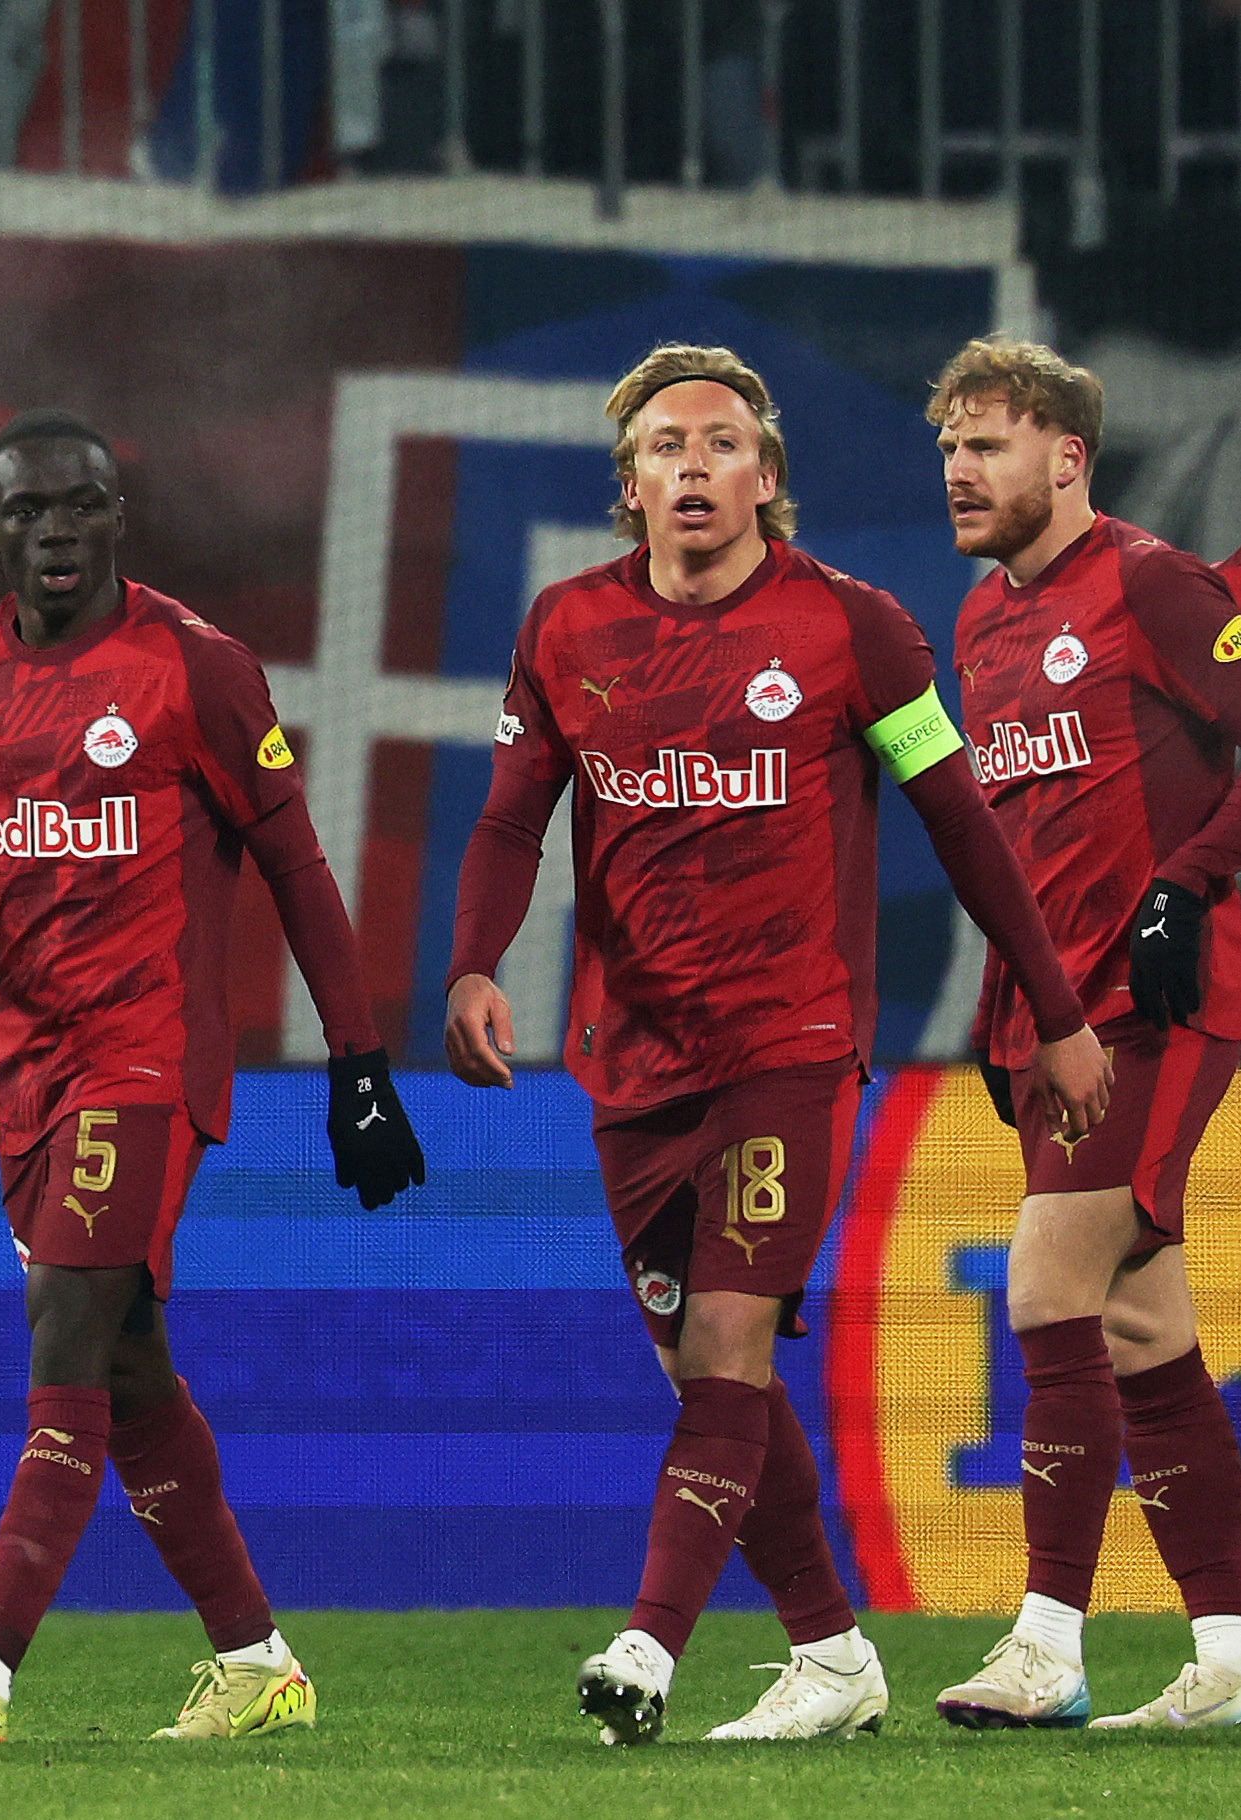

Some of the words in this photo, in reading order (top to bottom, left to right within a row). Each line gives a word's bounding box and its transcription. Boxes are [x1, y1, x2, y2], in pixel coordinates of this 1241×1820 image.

[890, 716, 944, 755] RESPECT
[965, 722, 1010, 783] ed
[1004, 710, 1092, 775] Bull
[579, 749, 679, 808] Red
[679, 748, 786, 809] Bull
[33, 796, 138, 859] Bull
[357, 1076, 372, 1093] 28
[72, 1109, 119, 1193] 5
[721, 1136, 786, 1225] 18
